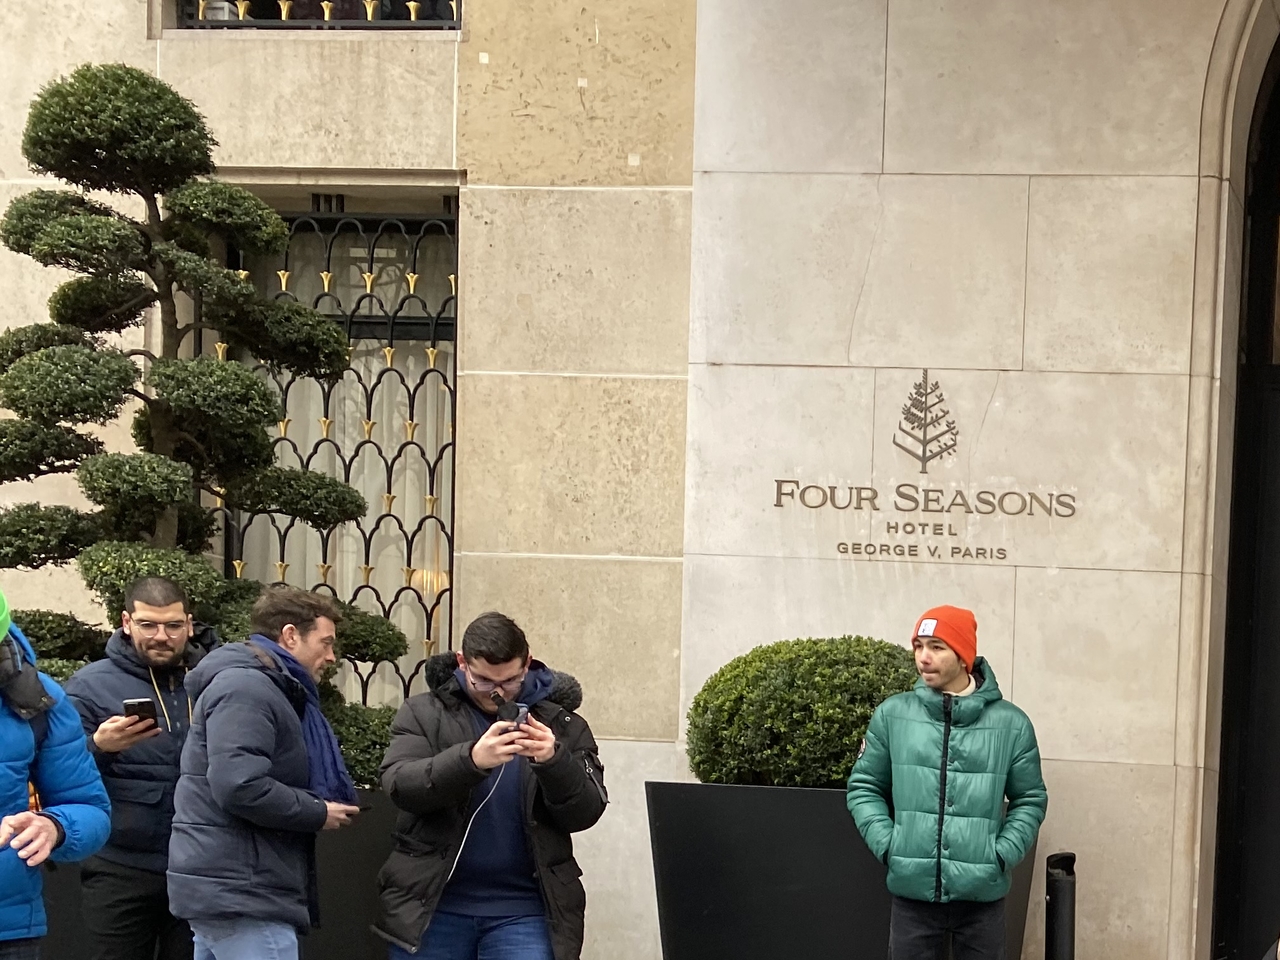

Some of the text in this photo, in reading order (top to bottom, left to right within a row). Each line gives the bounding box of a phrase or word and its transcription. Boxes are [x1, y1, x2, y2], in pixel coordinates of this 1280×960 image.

[773, 479, 1077, 518] FOUR SEASONS
[886, 521, 958, 536] HOTEL
[836, 542, 1007, 560] GEORGE V, PARIS
